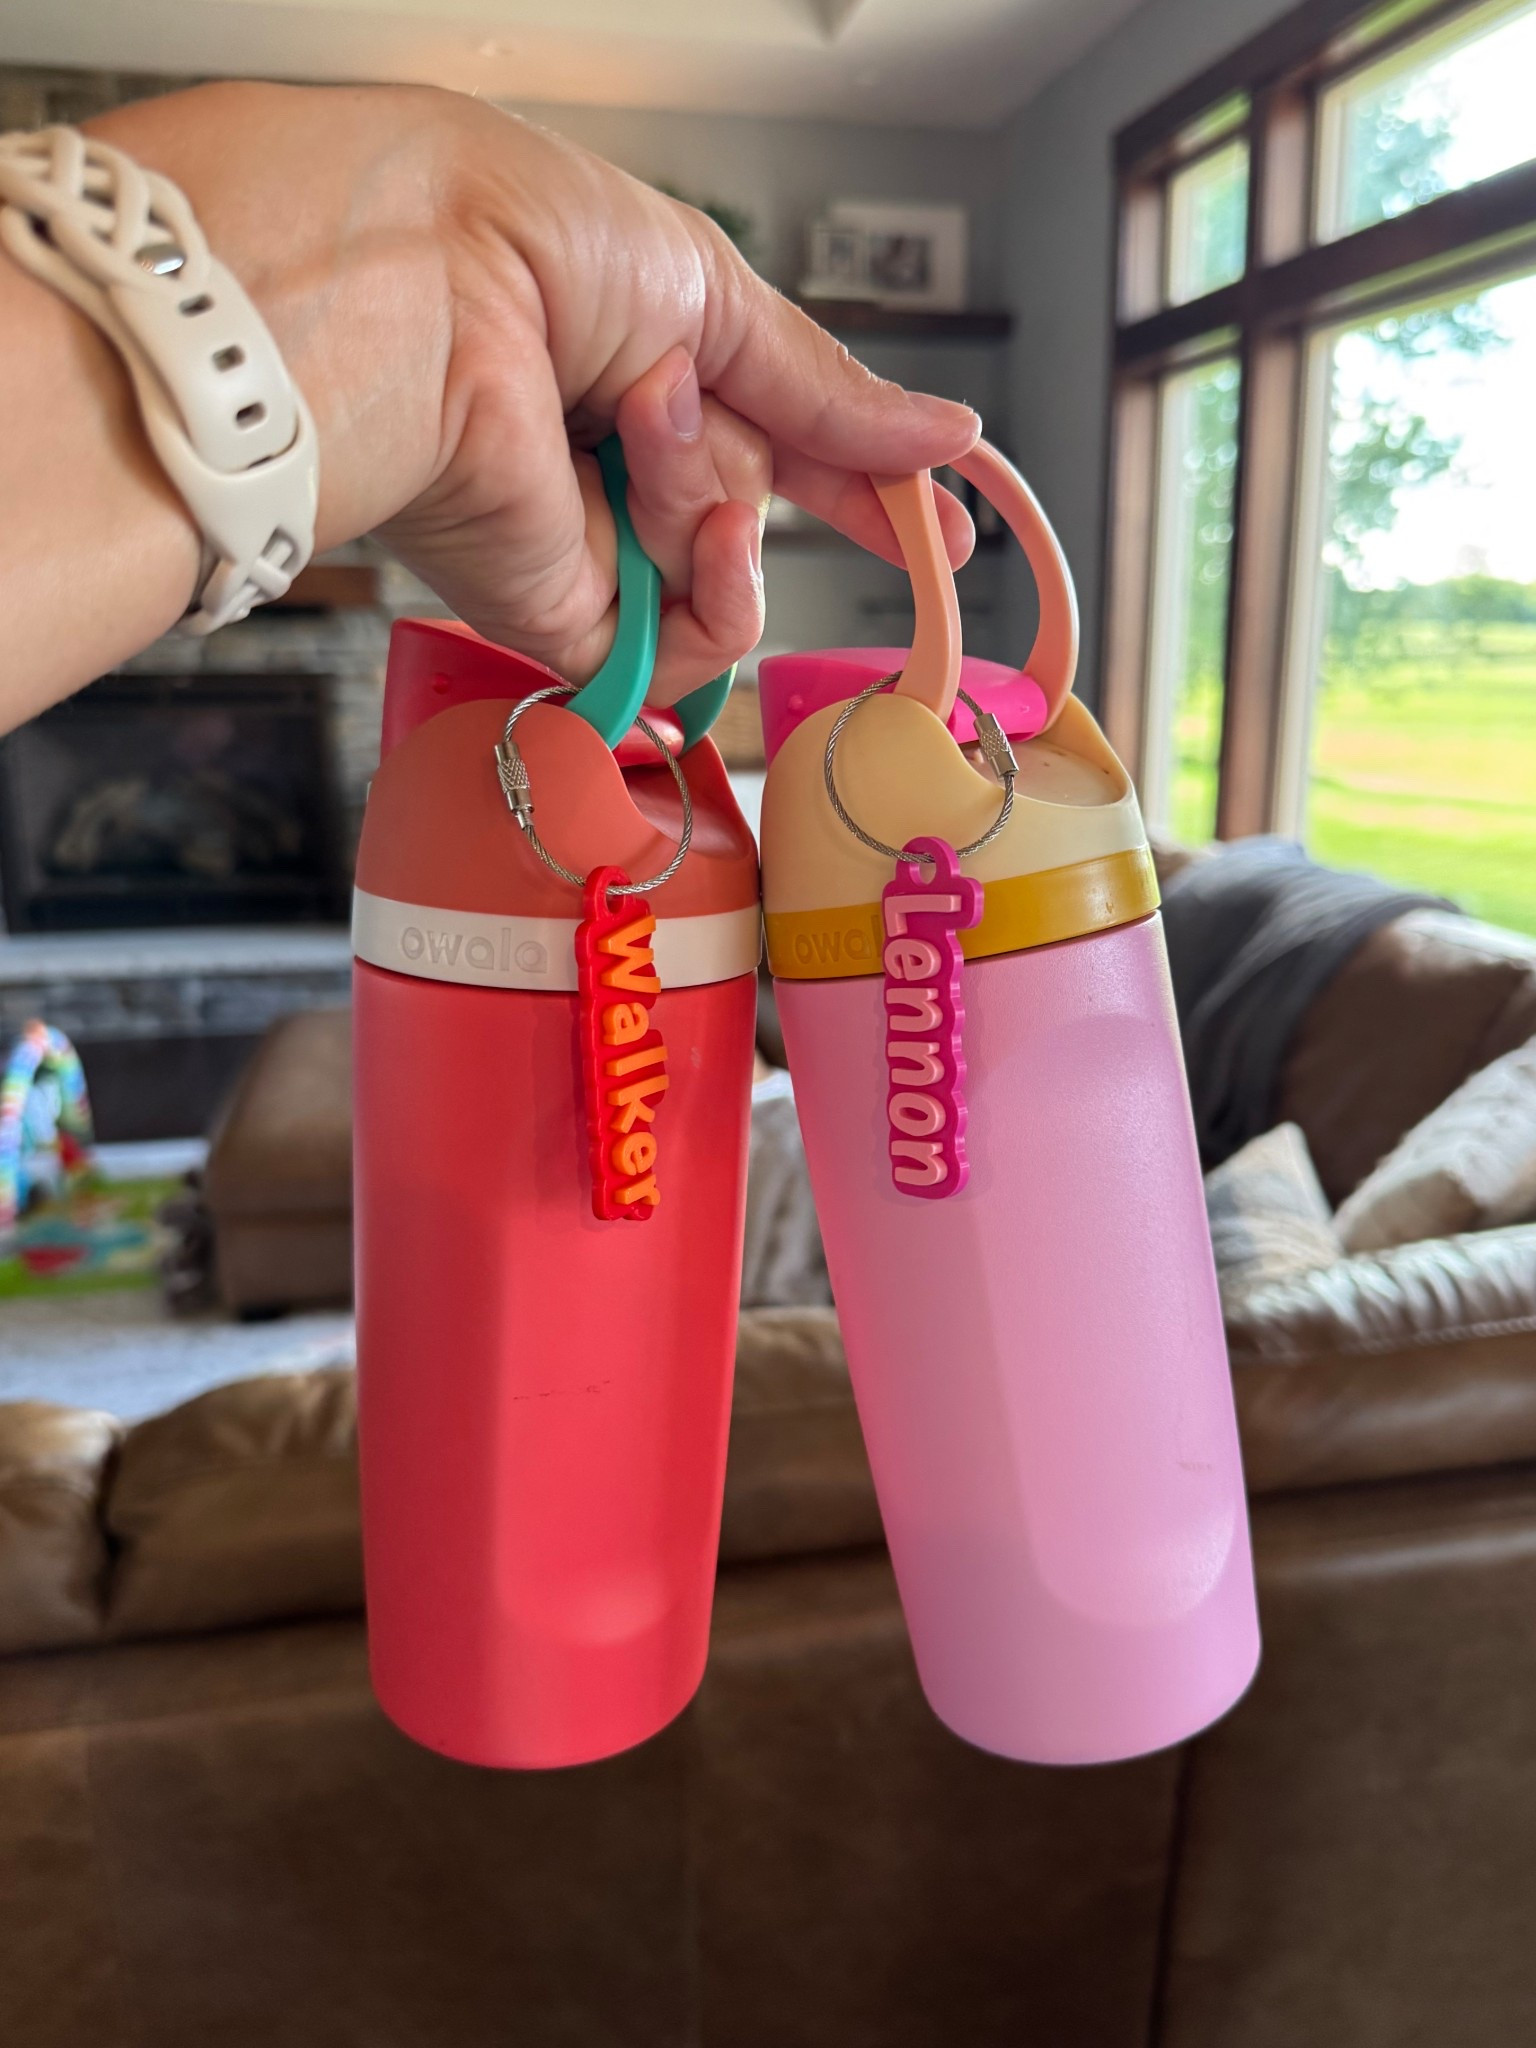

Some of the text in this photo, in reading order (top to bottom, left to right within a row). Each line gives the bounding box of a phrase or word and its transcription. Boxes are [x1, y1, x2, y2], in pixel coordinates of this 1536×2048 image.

[401, 926, 547, 974] owala
[795, 914, 883, 965] owal
[598, 914, 670, 1206] Walker
[884, 894, 962, 1186] Lennon
